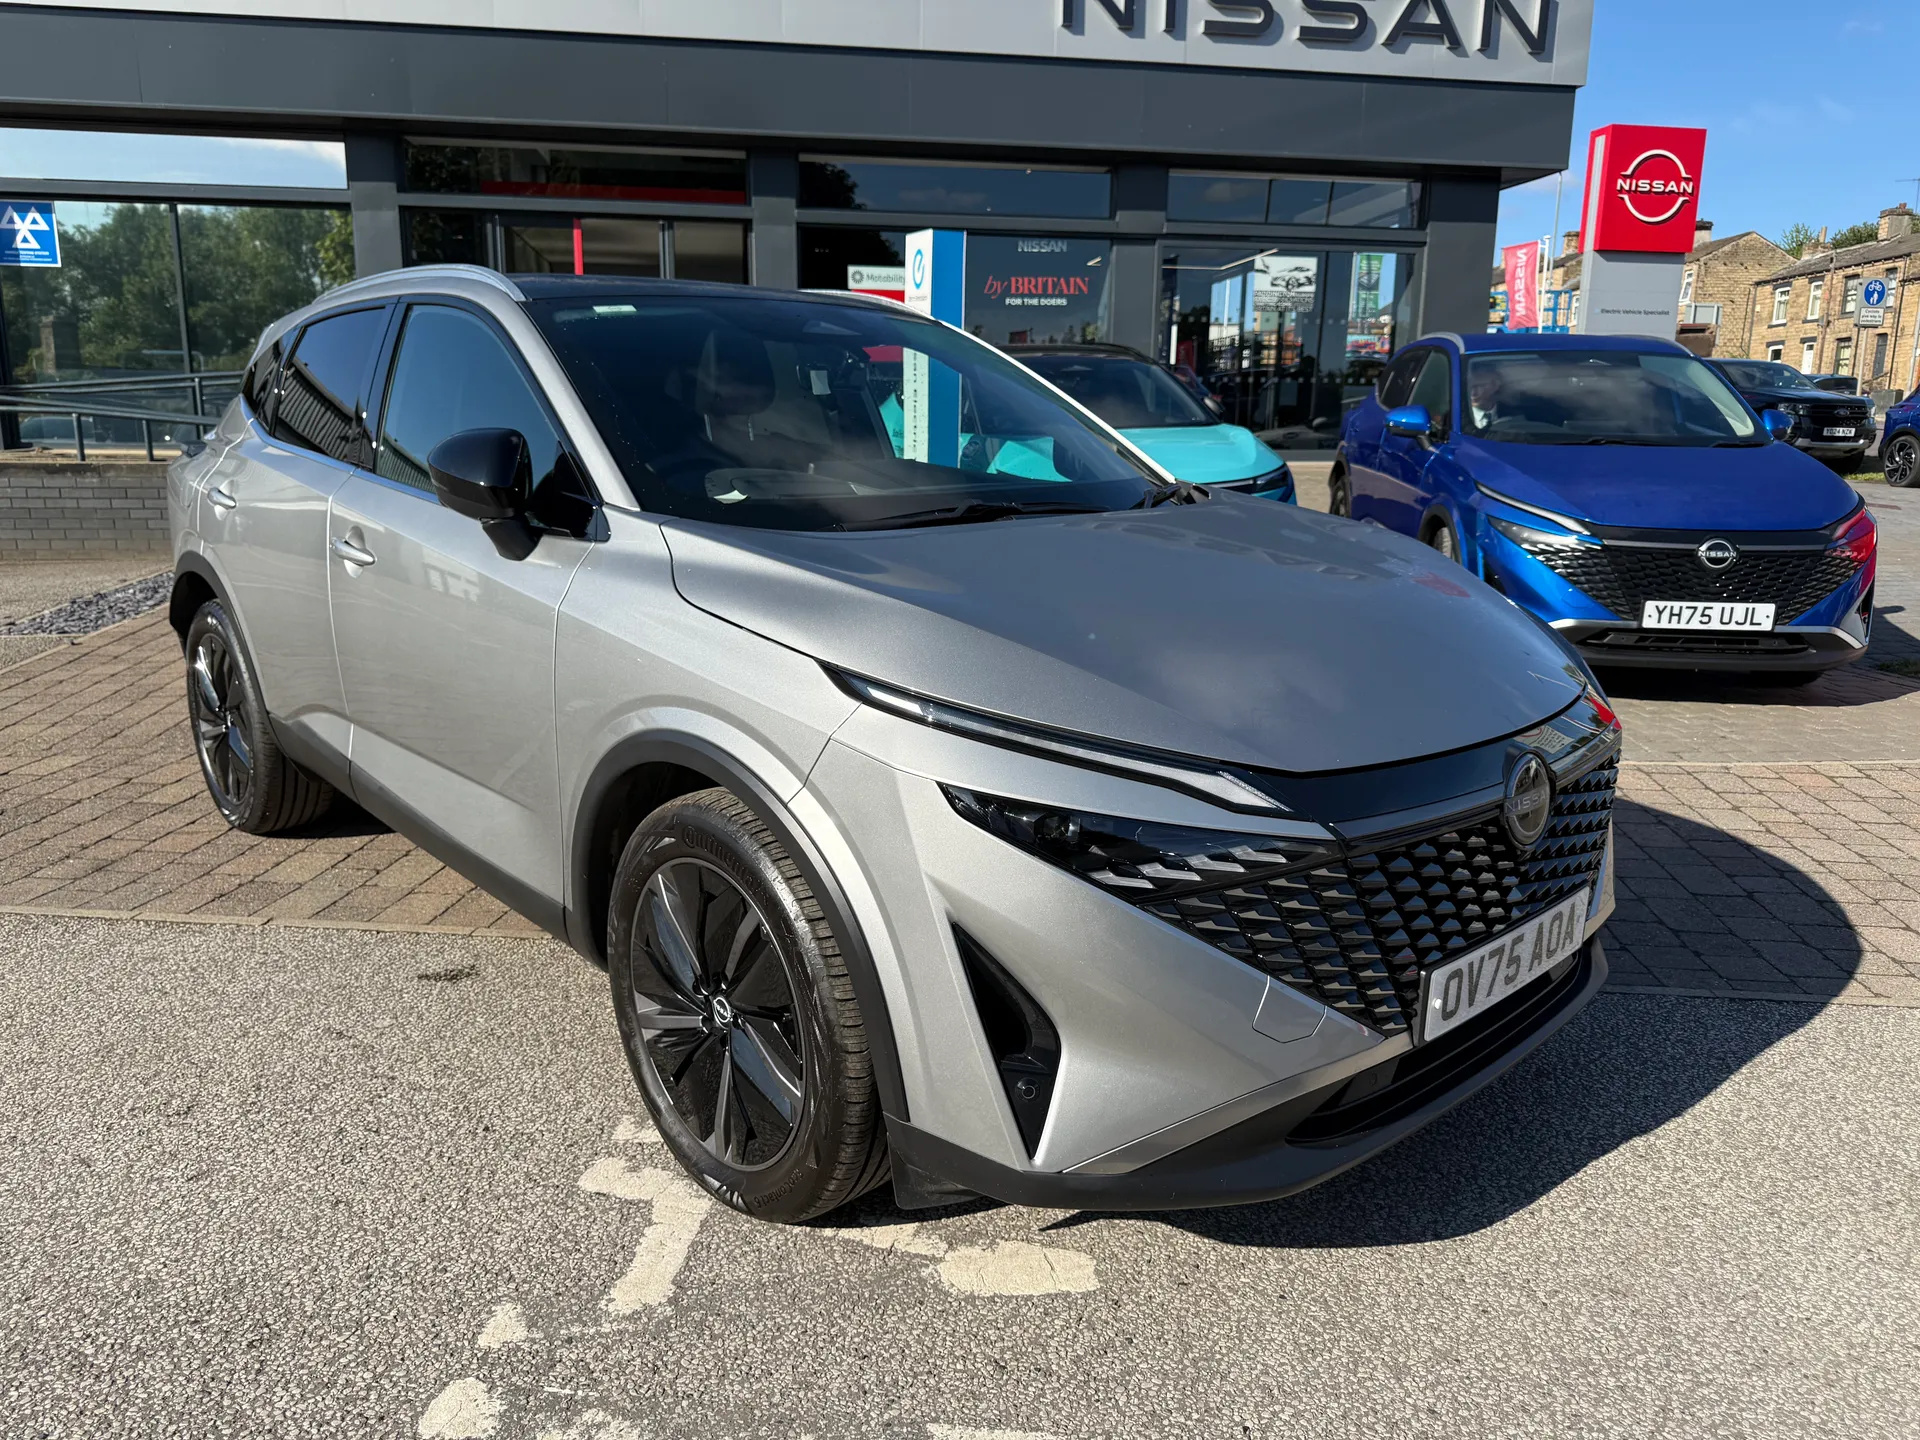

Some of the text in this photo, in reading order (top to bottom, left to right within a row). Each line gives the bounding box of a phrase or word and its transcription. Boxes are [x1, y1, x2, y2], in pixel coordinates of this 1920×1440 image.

[1616, 178, 1694, 194] NISSAN
[1017, 240, 1068, 252] NISSAN
[983, 275, 1089, 300] by BRITAIN
[1005, 297, 1067, 306] FOR THE DOERS
[1655, 605, 1762, 626] YH75 UJL
[1505, 789, 1549, 813] NISSA
[1441, 902, 1576, 1022] OV75 AOA
